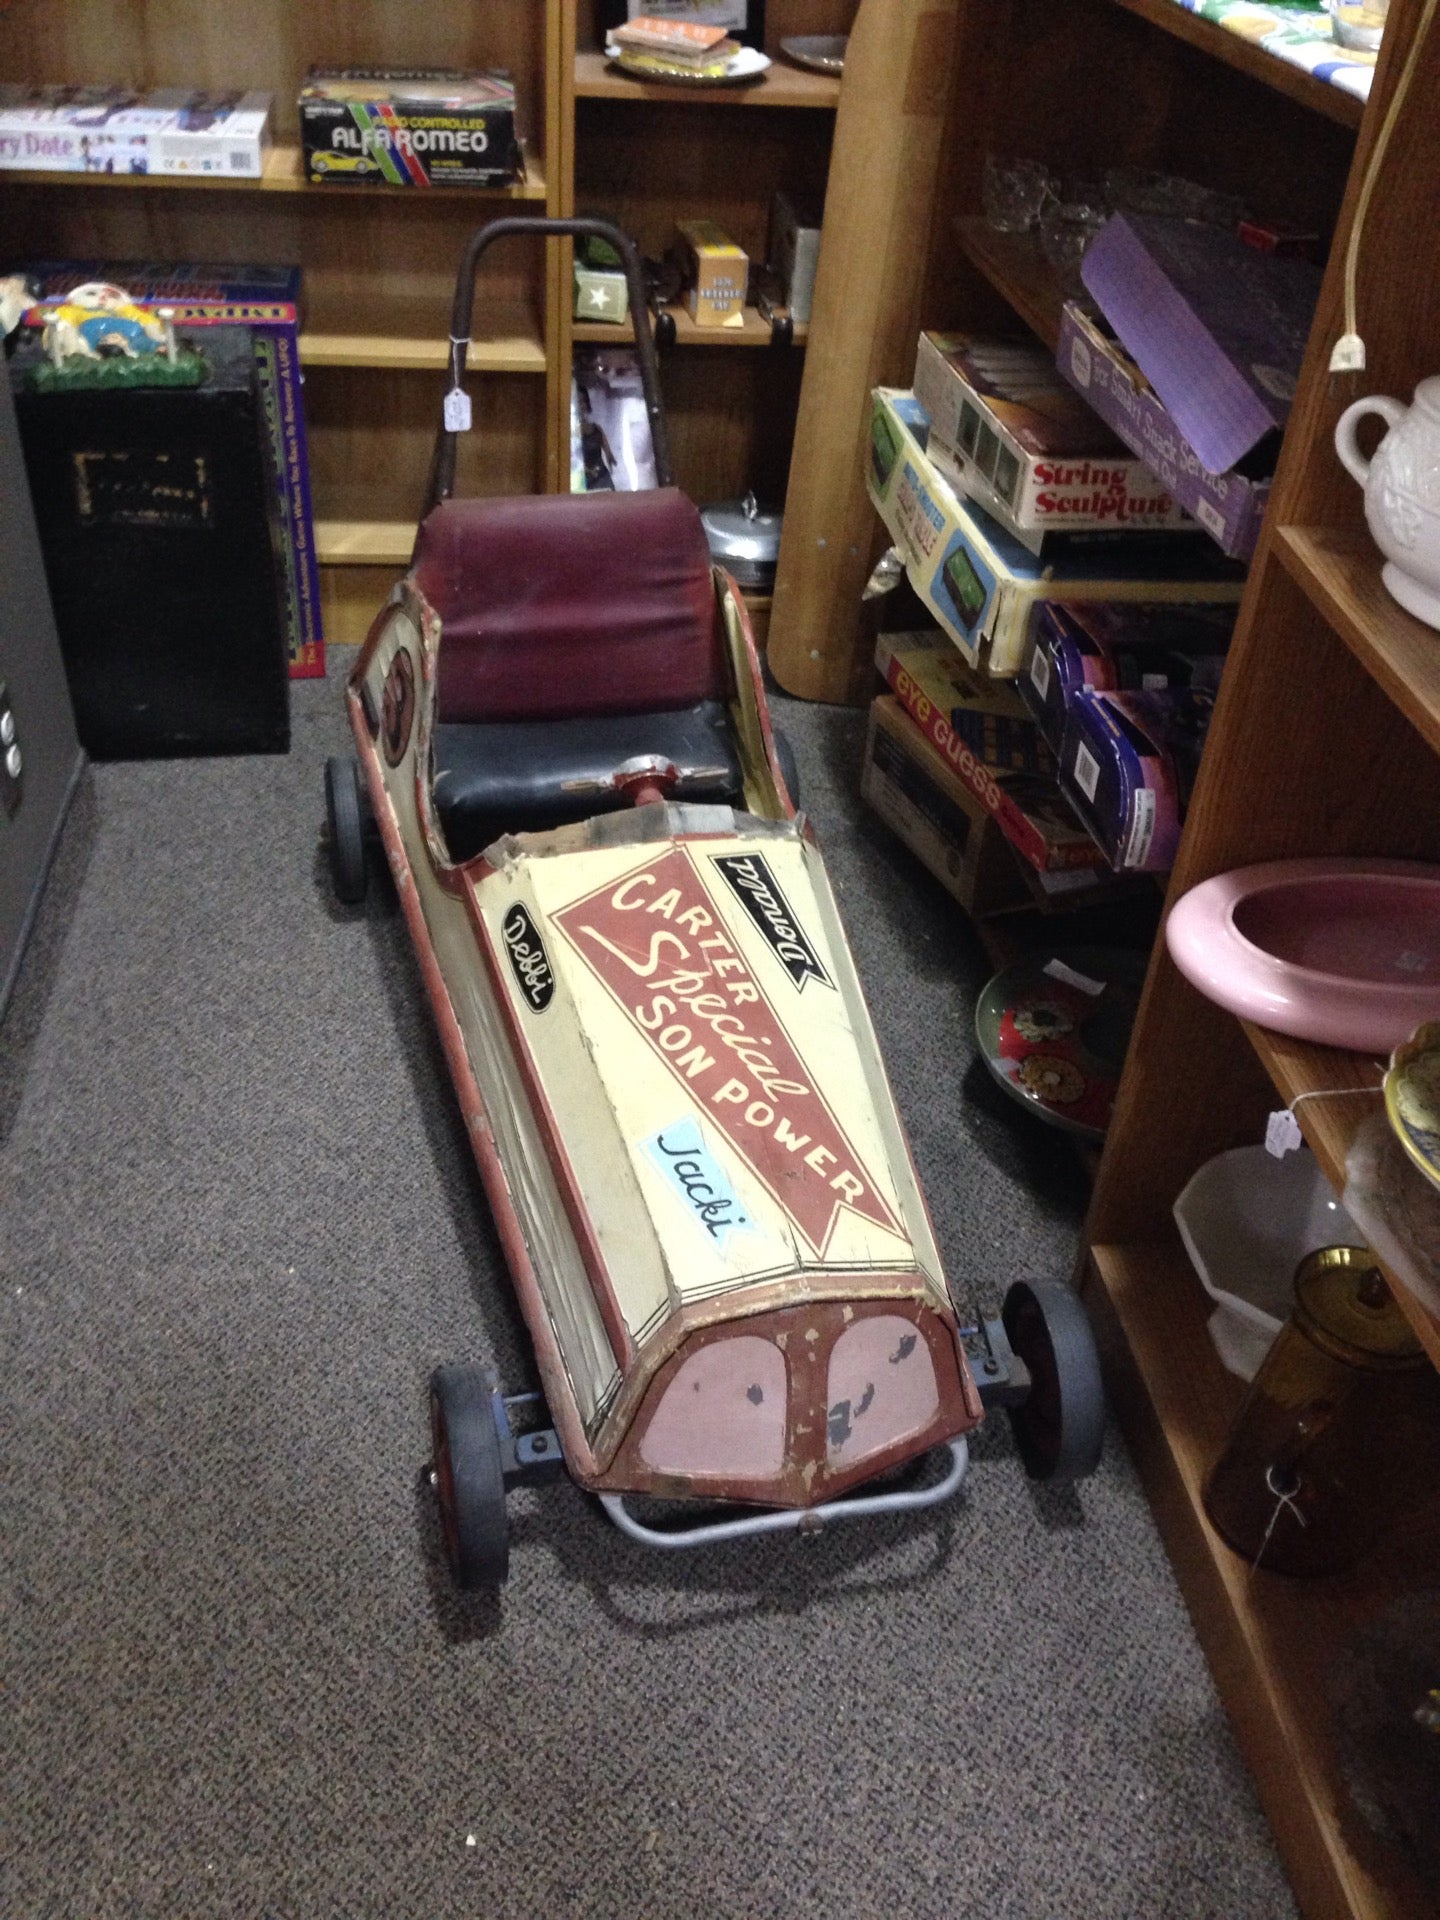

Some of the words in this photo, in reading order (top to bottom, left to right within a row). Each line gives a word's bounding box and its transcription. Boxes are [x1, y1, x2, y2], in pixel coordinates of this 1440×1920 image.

[26, 132, 73, 156] Date
[331, 127, 392, 156] ALFA
[394, 129, 489, 157] ROMEO
[411, 117, 487, 130] CONTROLLED
[1033, 461, 1128, 496] String
[1034, 491, 1173, 521] Sculpture
[610, 873, 761, 1006] CARTER
[727, 857, 813, 970] Donald
[503, 914, 553, 1004] Debbi
[578, 925, 810, 1103] Special
[635, 995, 716, 1079] SON
[710, 1077, 866, 1204] POWER
[656, 1134, 747, 1238] Jacki
